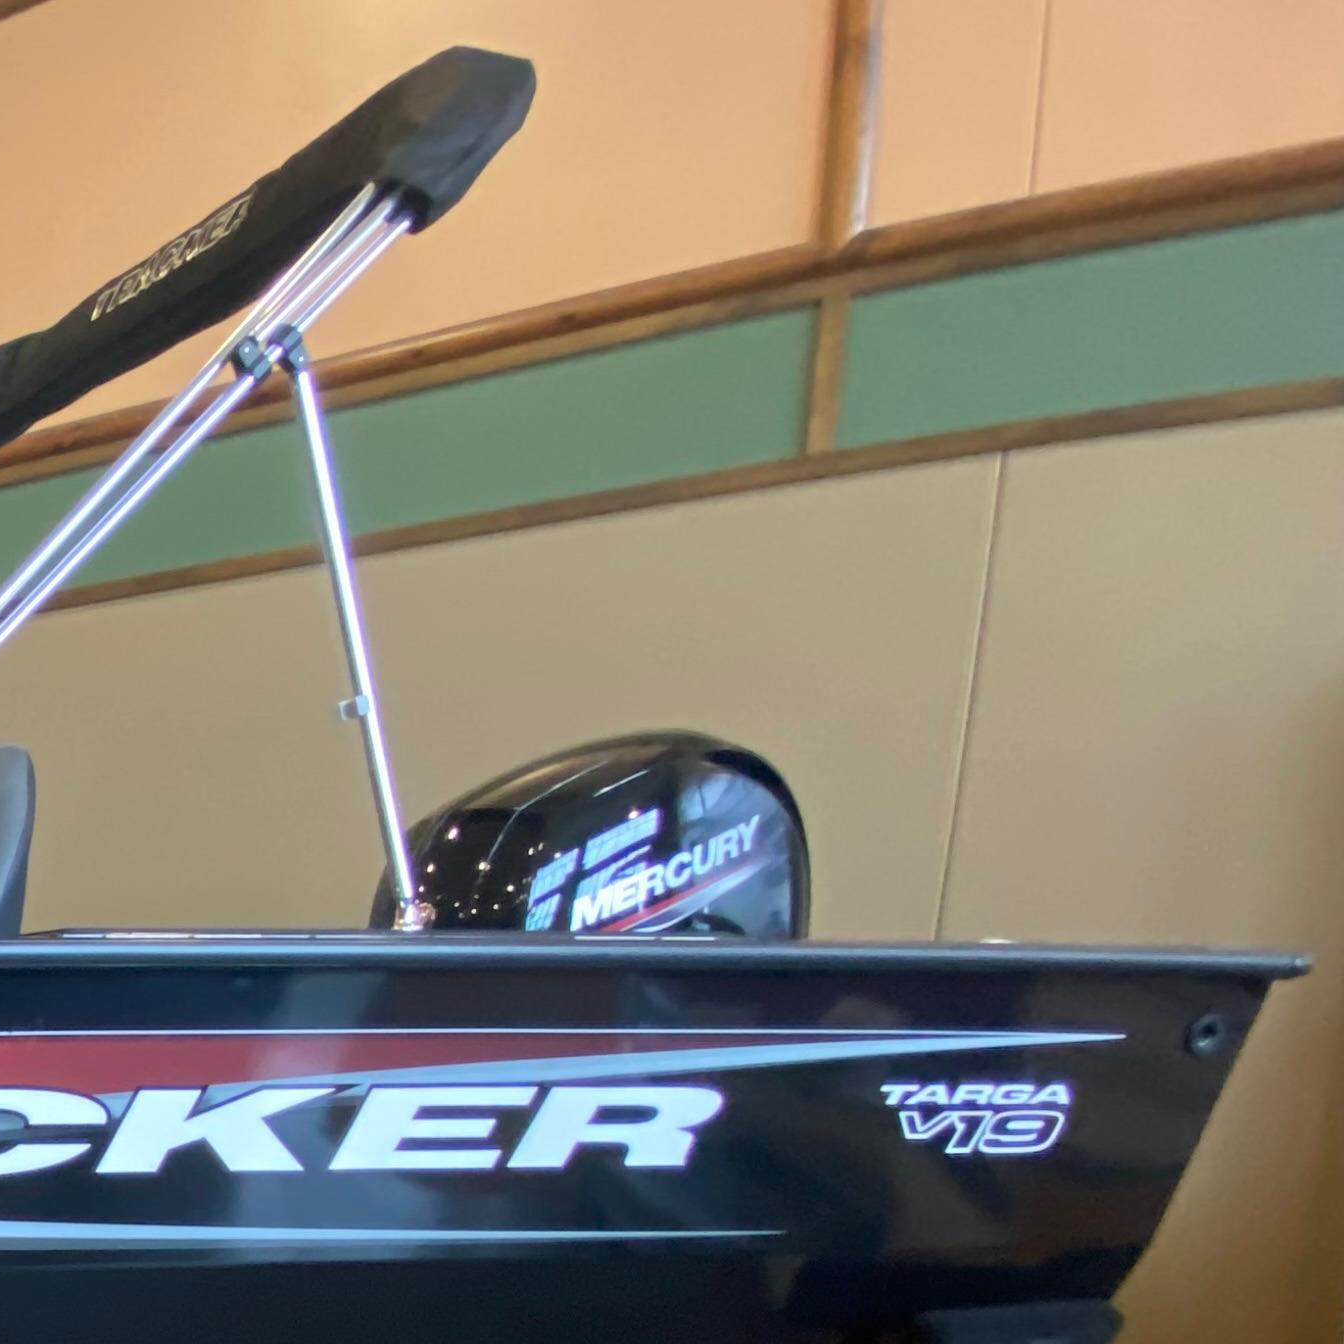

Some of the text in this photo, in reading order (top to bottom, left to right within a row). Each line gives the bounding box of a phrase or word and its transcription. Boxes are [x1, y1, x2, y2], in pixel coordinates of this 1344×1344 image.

[570, 814, 760, 932] MERCURY
[880, 1084, 1070, 1106] TARGA
[899, 1110, 1065, 1154] V19
